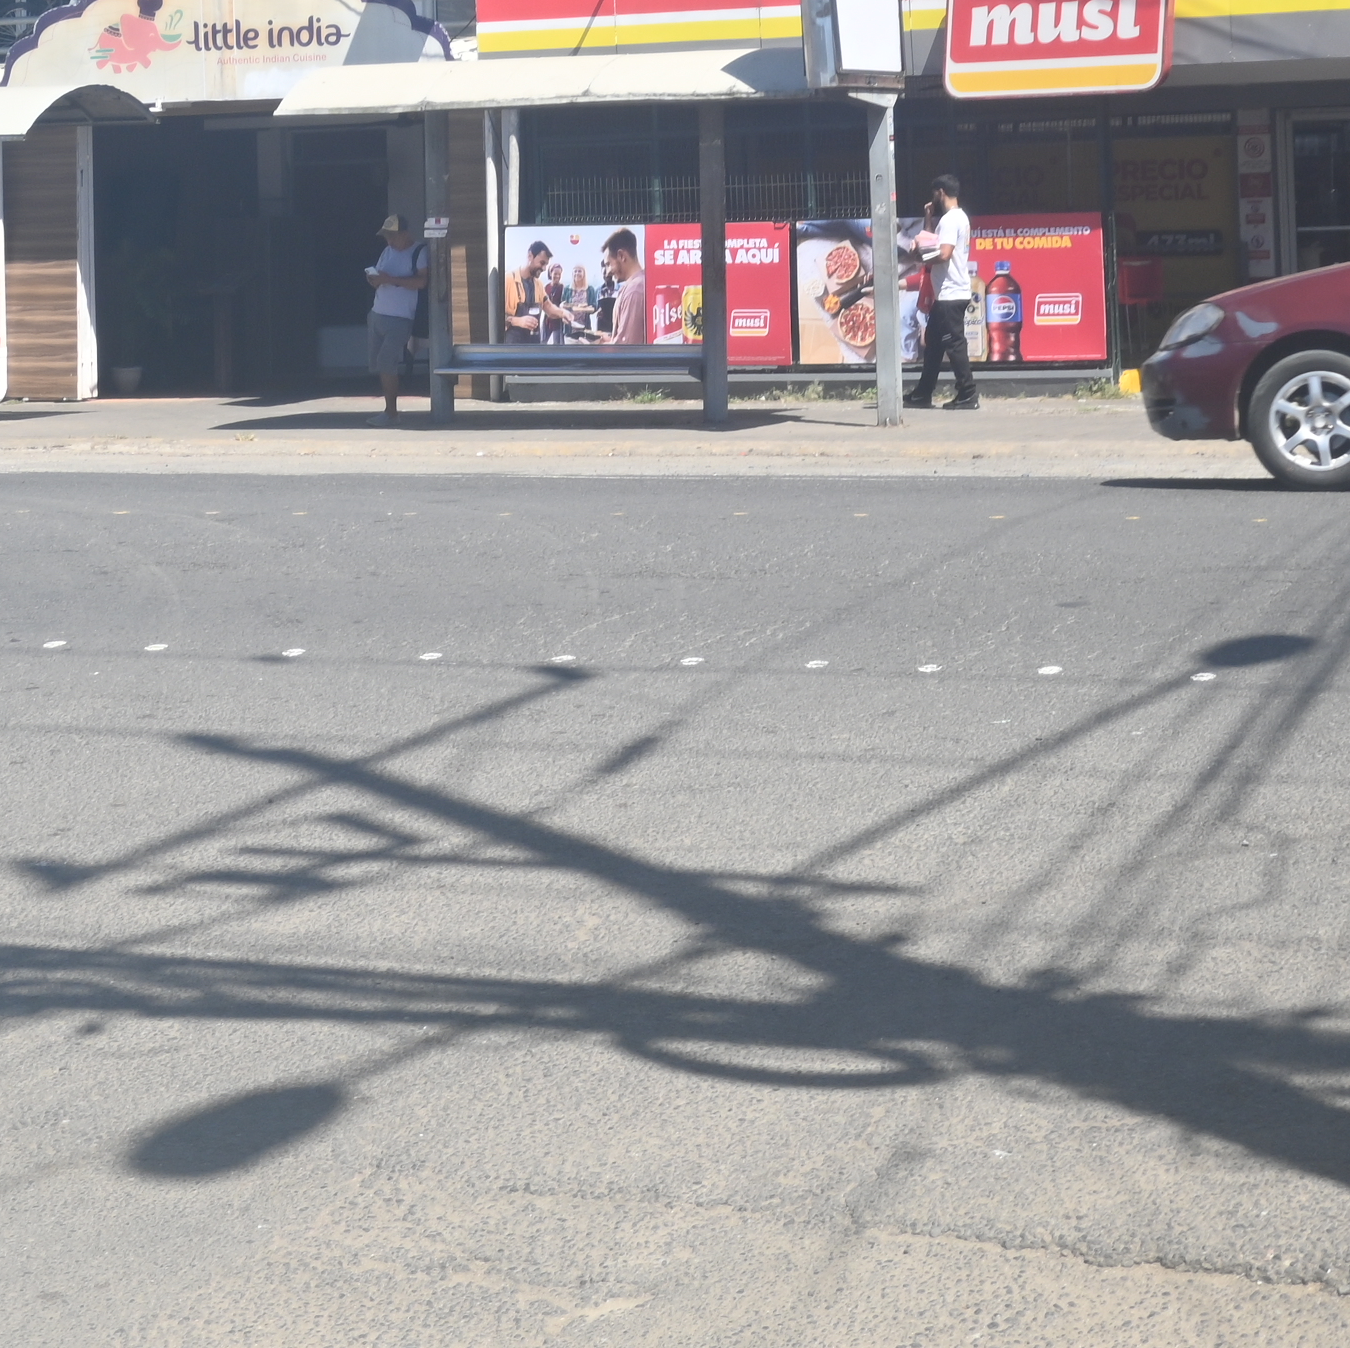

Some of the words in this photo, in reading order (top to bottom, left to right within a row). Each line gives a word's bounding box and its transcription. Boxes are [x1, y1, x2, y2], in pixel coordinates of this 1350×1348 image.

[185, 18, 260, 52] little
[267, 14, 351, 49] india
[216, 54, 260, 66] Authentic
[262, 53, 291, 64] Indian
[292, 52, 327, 63] Cuisine
[981, 225, 1005, 238] ESTÁ
[1006, 228, 1016, 237] EL
[1016, 225, 1091, 237] COMPLEMENTO
[663, 239, 678, 250] LA
[678, 238, 702, 249] FIEST
[975, 237, 994, 251] DE
[994, 237, 1014, 250] TU
[1014, 235, 1072, 250] COMIDA
[653, 249, 675, 266] SE
[676, 249, 734, 265] ARA
[734, 242, 780, 265] AQUÍ
[1039, 298, 1077, 315] musi
[734, 313, 766, 328] musi
